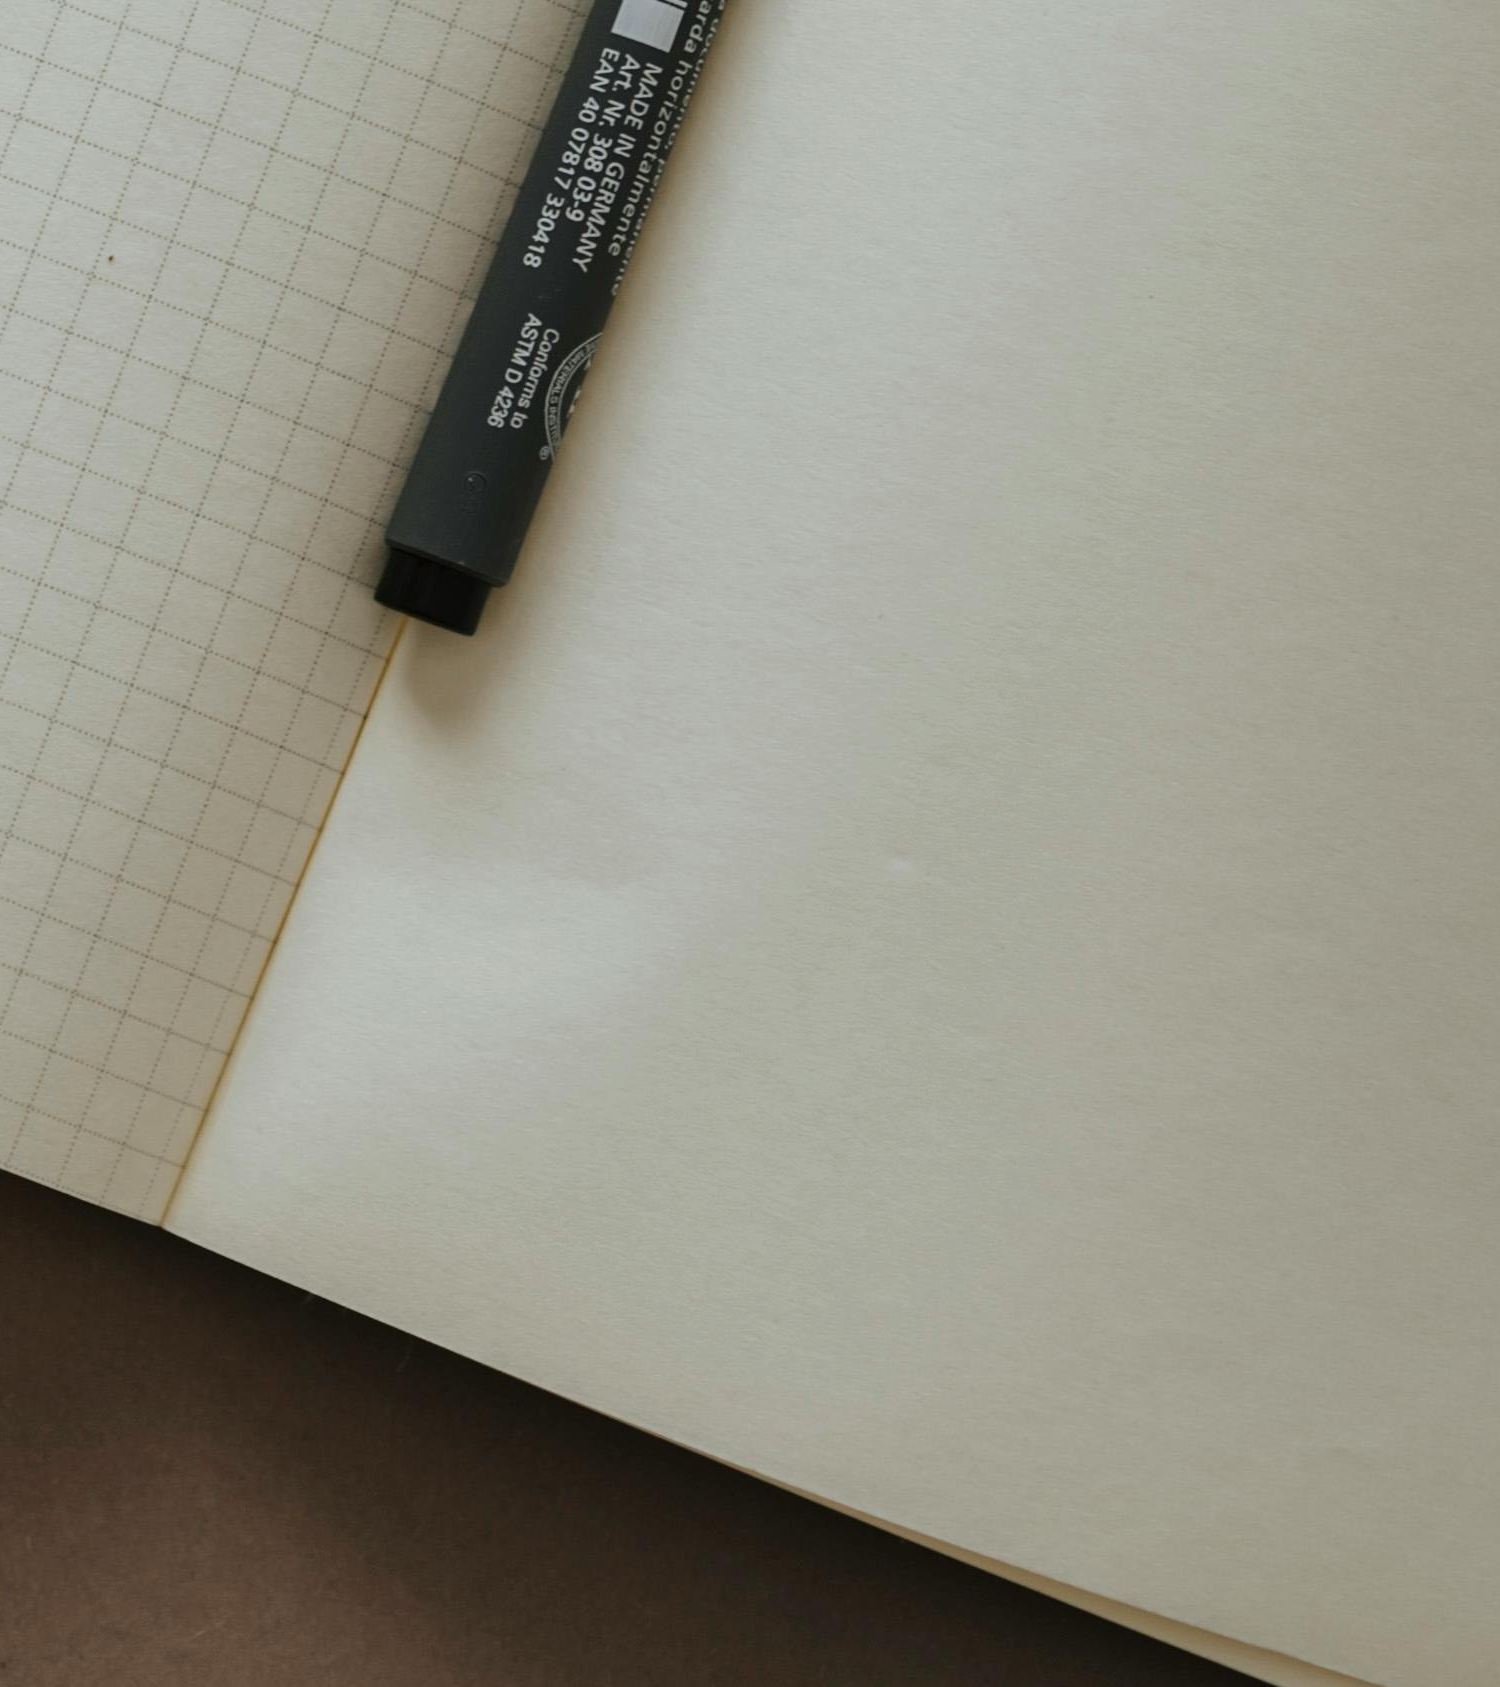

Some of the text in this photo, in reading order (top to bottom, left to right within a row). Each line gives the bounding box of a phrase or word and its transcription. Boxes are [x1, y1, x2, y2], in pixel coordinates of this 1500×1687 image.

[520, 46, 621, 269] EAN 40 07817 330418
[563, 53, 643, 223] Art. Nr. 308 03-9
[567, 61, 664, 272] MADE IN GERMANY
[601, 60, 695, 258] horizontalmente
[485, 312, 545, 429] ASTM D 4236
[508, 410, 528, 431] to
[515, 327, 561, 410] Conforms
